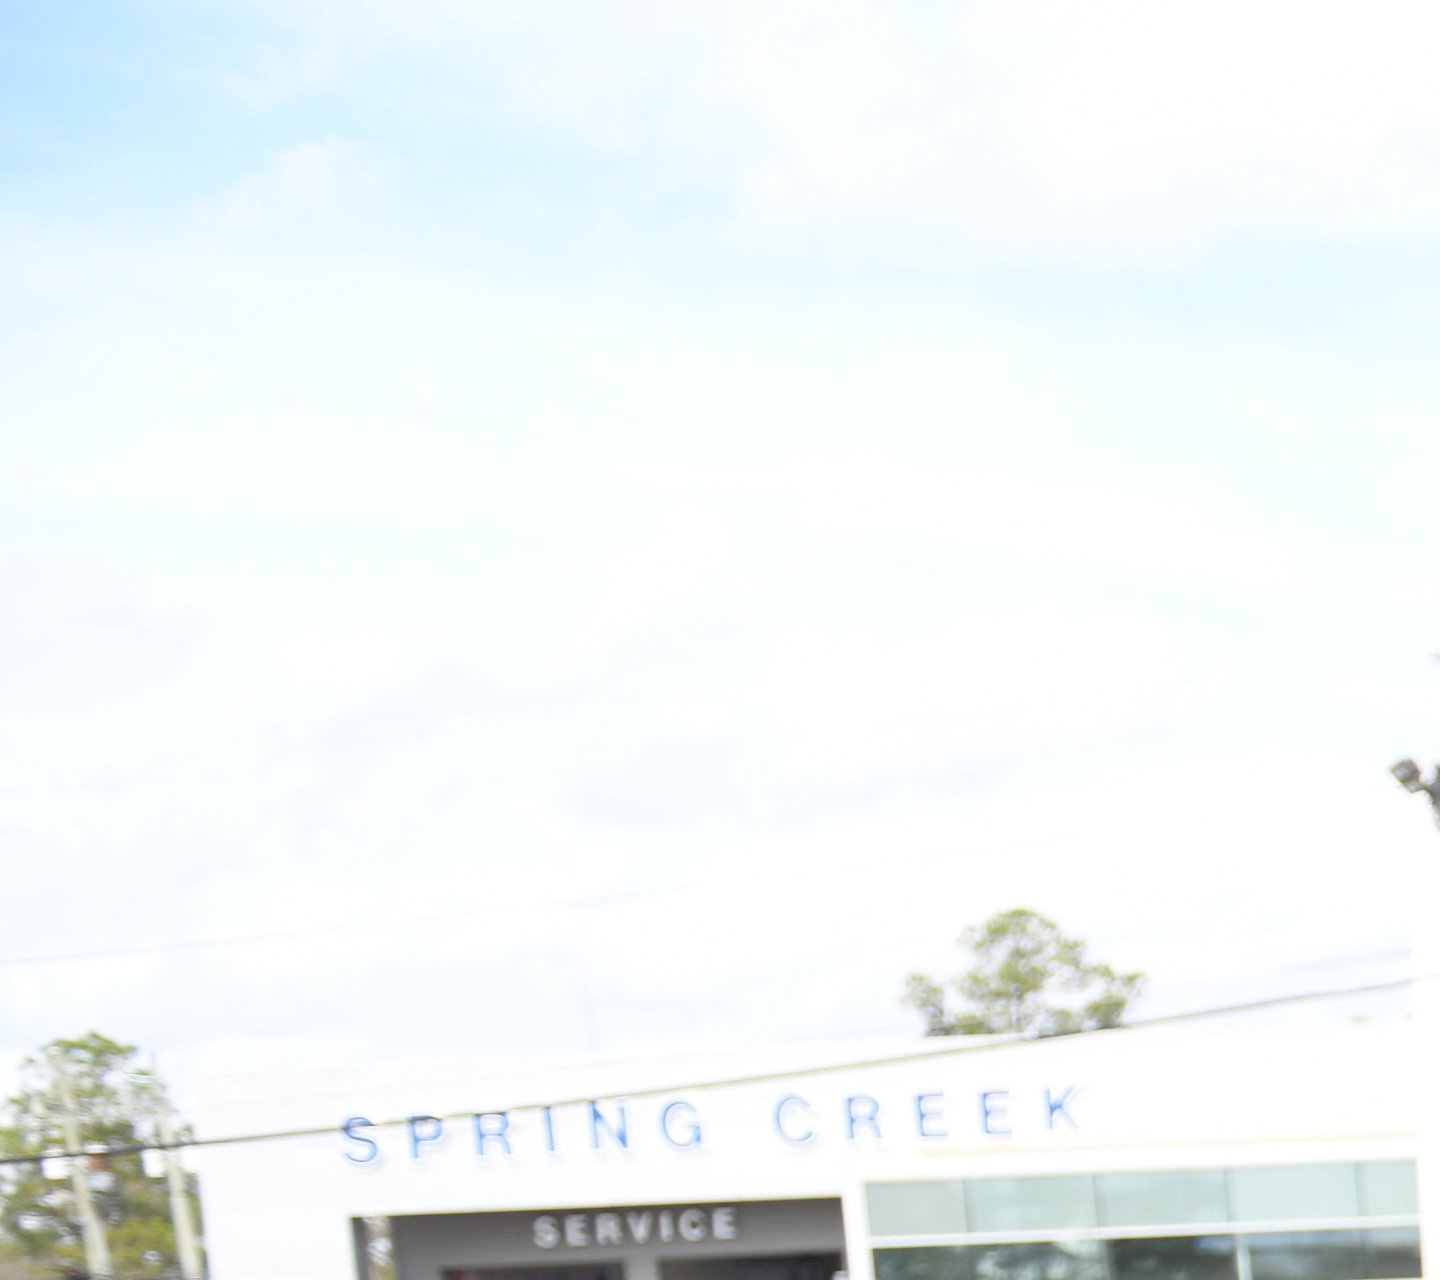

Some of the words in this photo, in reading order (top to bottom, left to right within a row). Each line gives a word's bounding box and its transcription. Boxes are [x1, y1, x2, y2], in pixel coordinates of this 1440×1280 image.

[342, 1100, 703, 1163] SPRING
[772, 1085, 1080, 1144] CREEK
[533, 1206, 738, 1249] SERVICE
